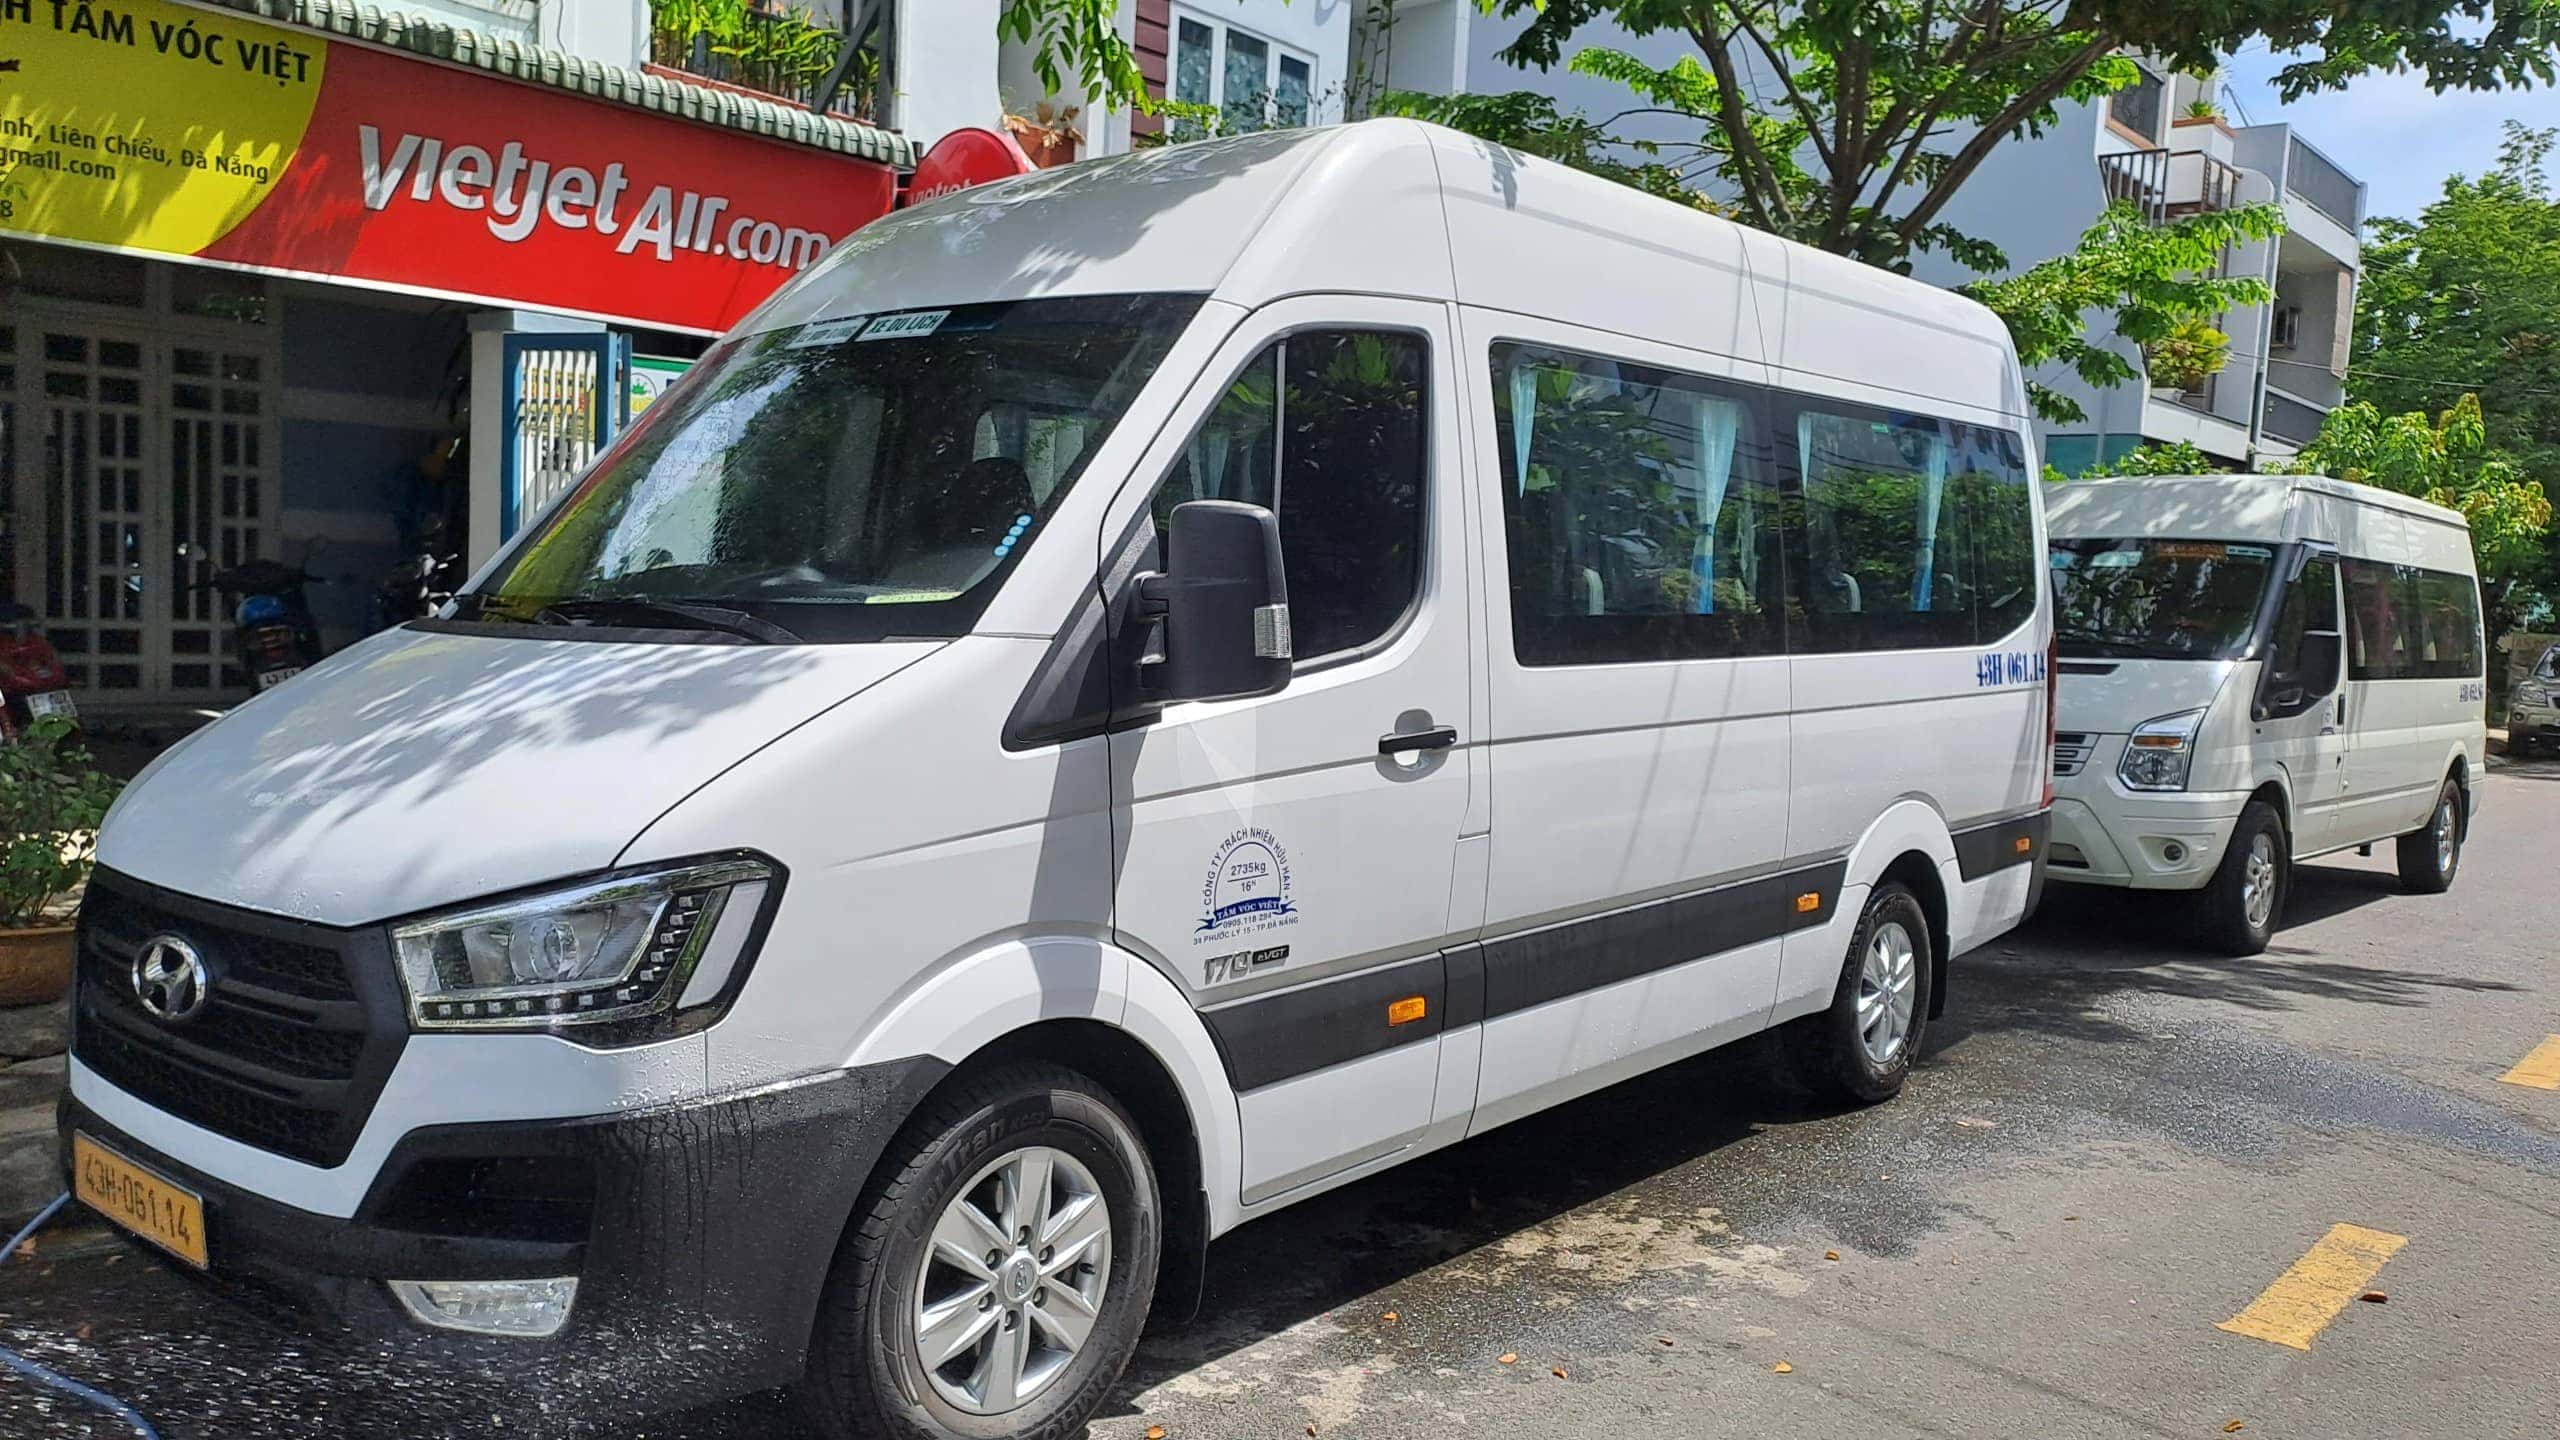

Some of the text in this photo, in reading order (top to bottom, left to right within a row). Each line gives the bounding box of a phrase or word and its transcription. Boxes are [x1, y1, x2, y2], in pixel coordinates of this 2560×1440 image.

[150, 19, 224, 65] VÓC
[237, 40, 311, 87] VIỆT
[50, 124, 96, 150] Liên
[104, 137, 172, 168] Chiểu,
[181, 148, 207, 170] Đà
[215, 153, 268, 185] Nẵng
[1976, 650, 2046, 687] 43H 061.14
[1211, 852, 1222, 867] TY
[1230, 861, 1266, 876] 2735kg
